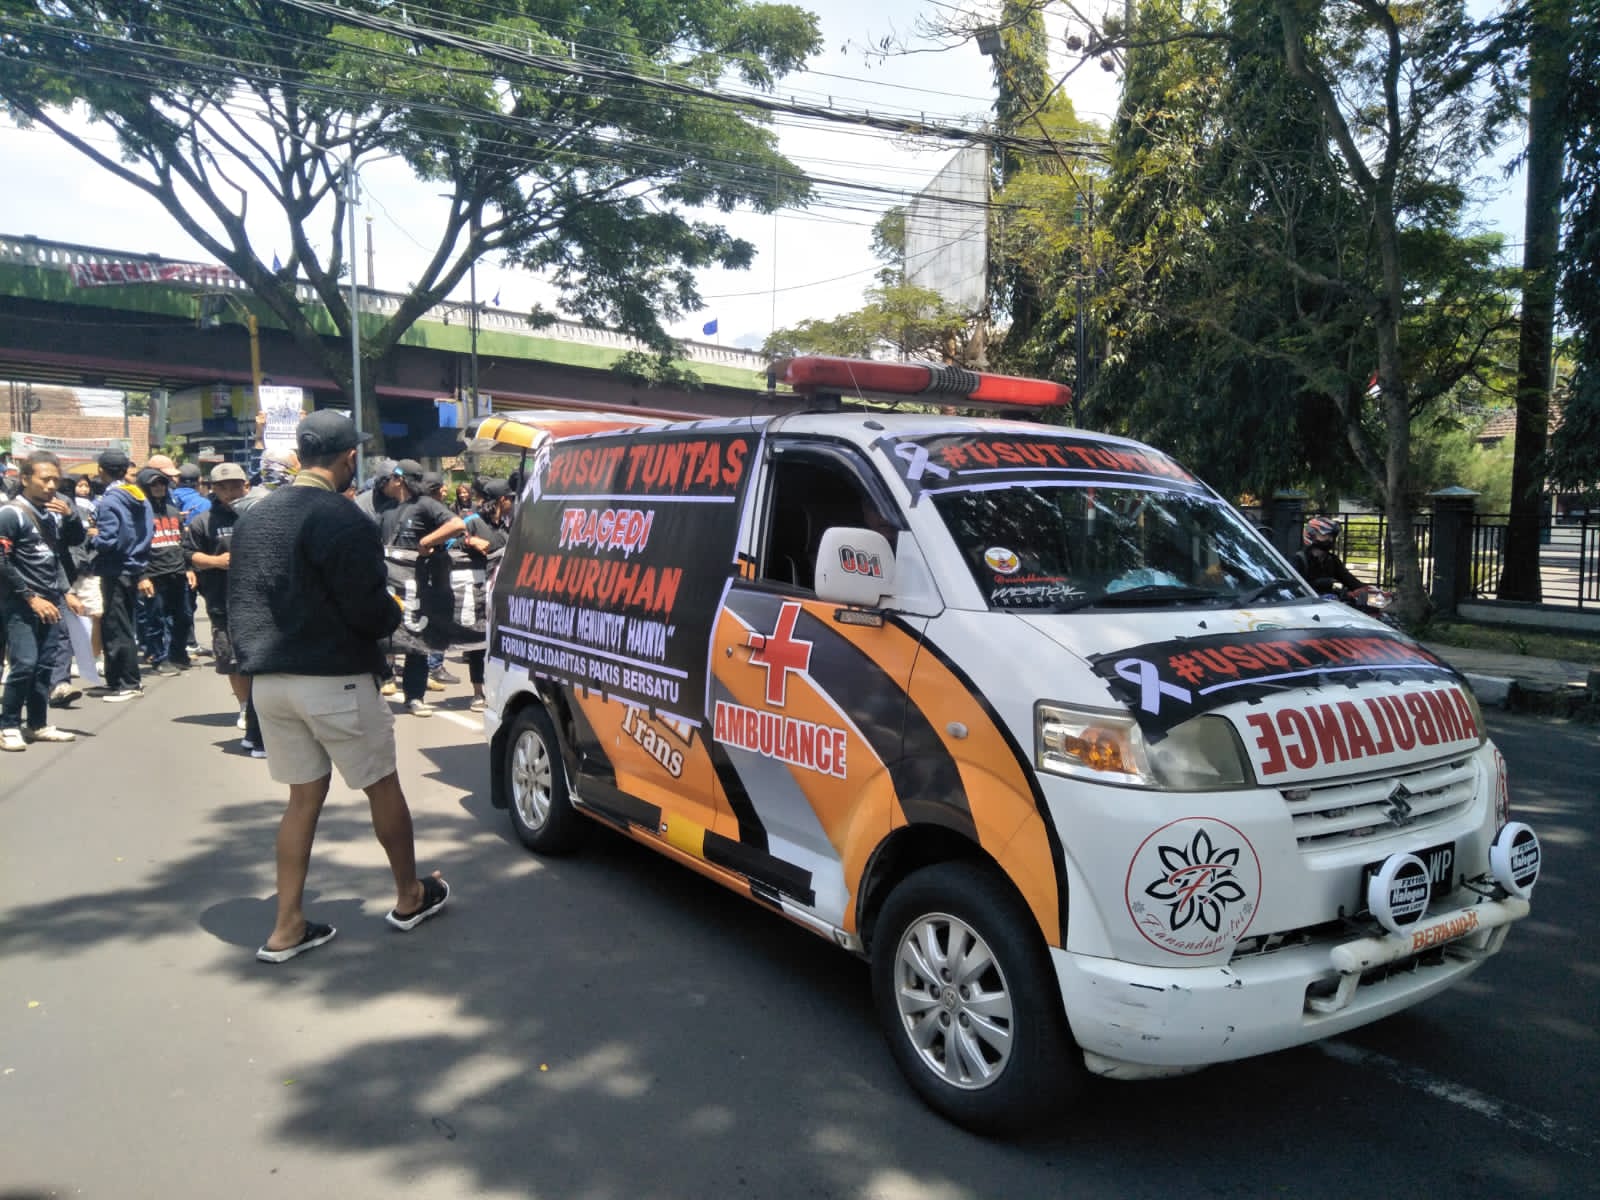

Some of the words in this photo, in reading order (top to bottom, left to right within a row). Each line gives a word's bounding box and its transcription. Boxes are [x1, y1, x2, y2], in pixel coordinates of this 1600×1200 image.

[546, 445, 624, 490] #USUT
[625, 439, 748, 492] TUNTAS
[940, 442, 1069, 468] #USUT
[560, 508, 655, 557] TRAGEDI
[515, 552, 682, 617] KANJURUHAN
[839, 545, 883, 578] 001
[535, 600, 576, 638] BERTERIAK
[576, 607, 626, 650] MENUNTUT
[501, 635, 527, 659] FORUM
[528, 643, 587, 677] SOLIDARITAS
[588, 659, 620, 686] PAKIS
[623, 669, 679, 703] BERSATU
[1168, 639, 1314, 685] #USUT
[622, 703, 684, 778] Trans
[713, 700, 847, 779] AMBULANCE
